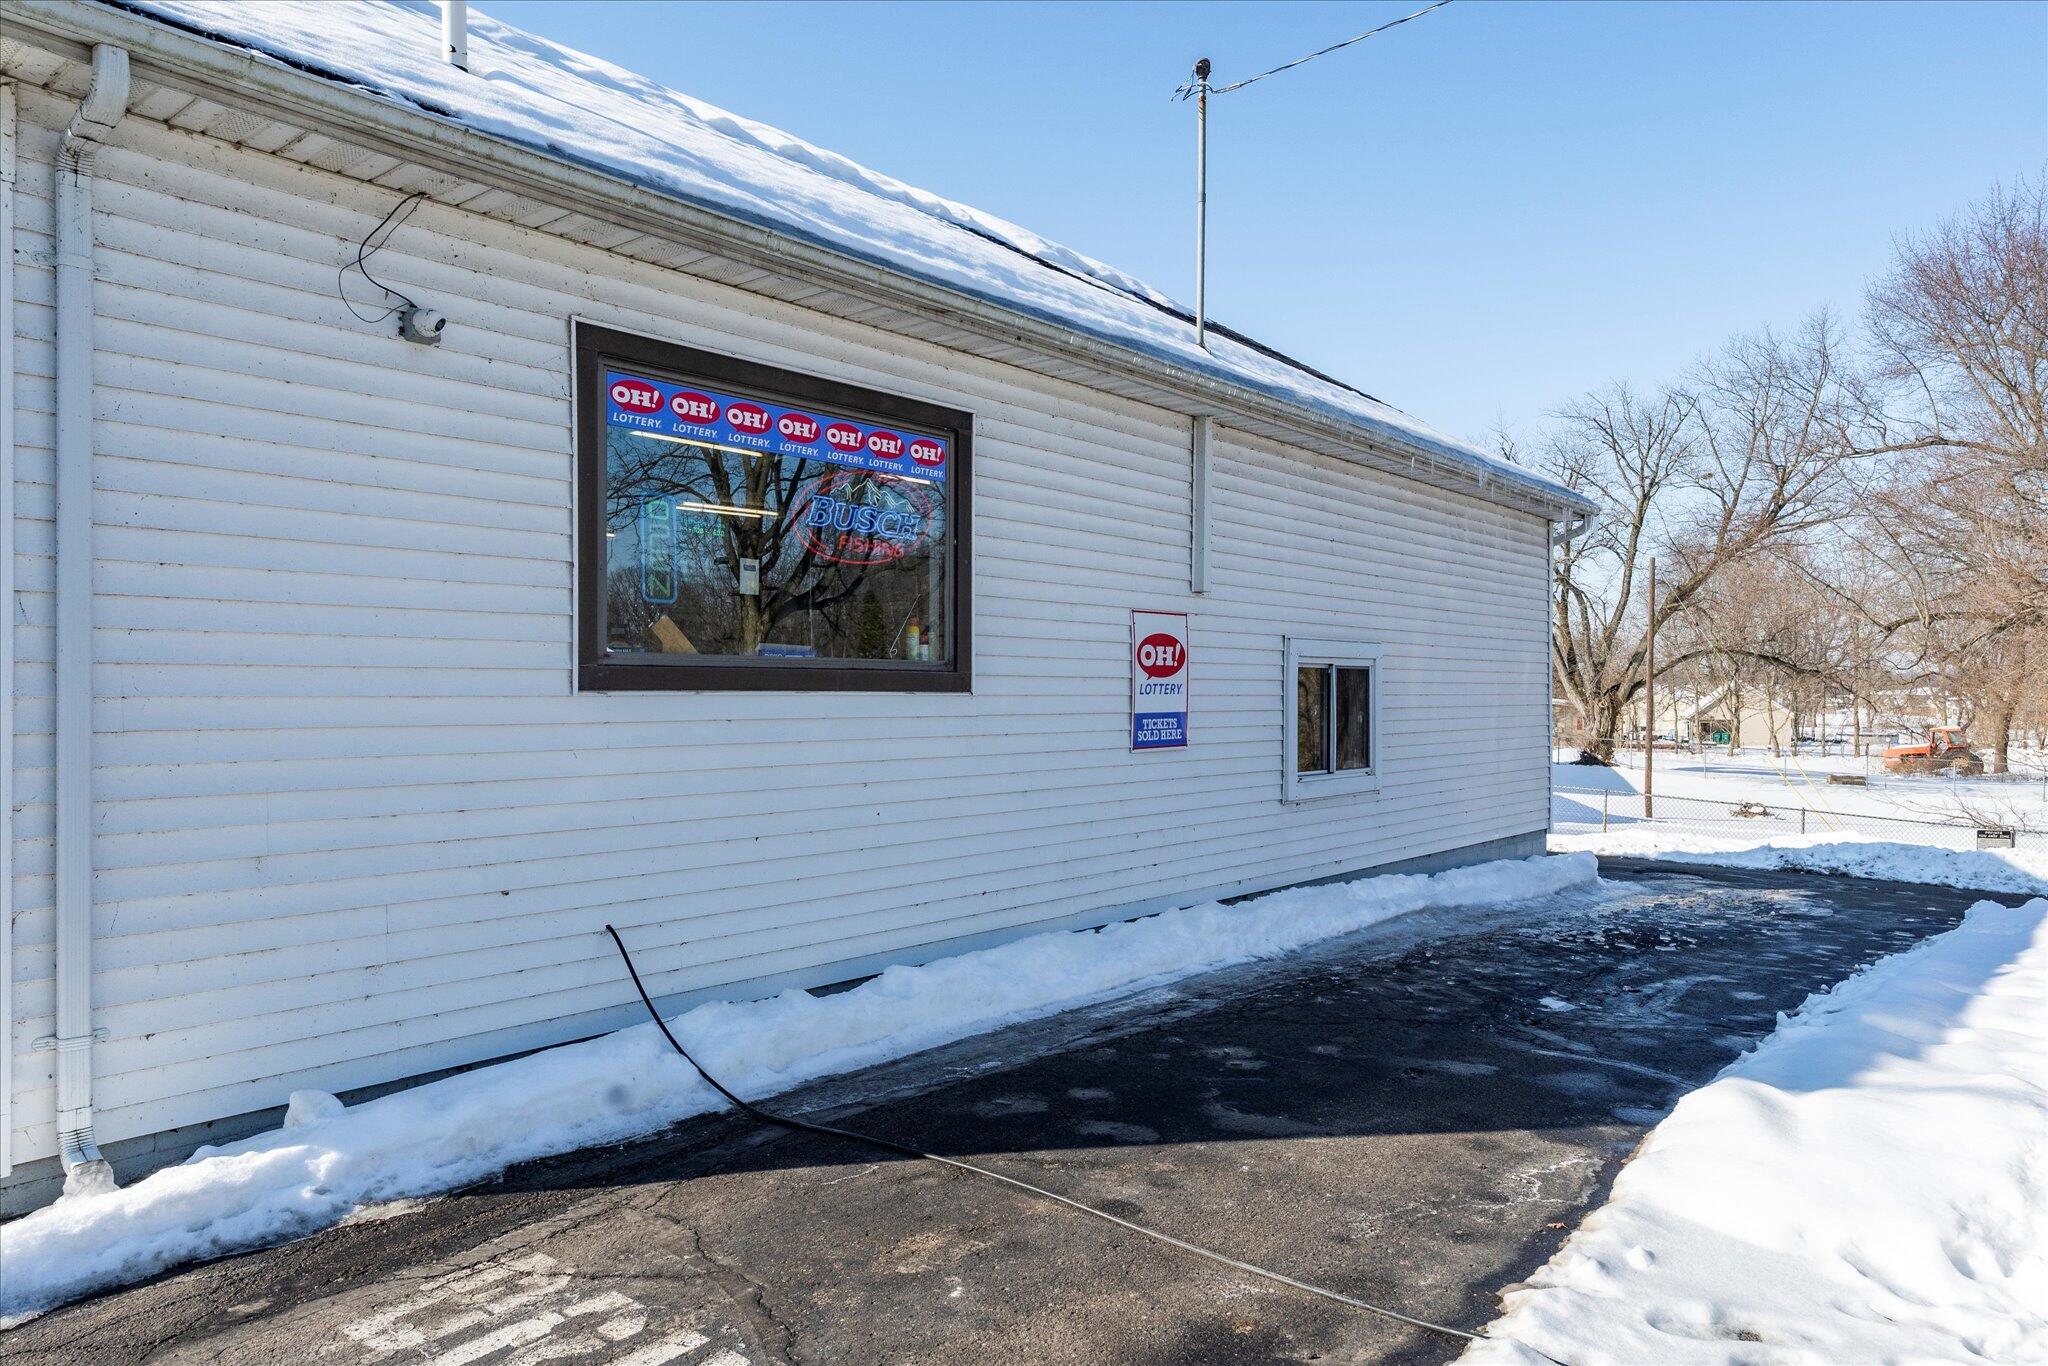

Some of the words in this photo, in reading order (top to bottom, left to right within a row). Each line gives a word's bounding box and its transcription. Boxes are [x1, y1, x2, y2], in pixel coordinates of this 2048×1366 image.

[612, 385, 659, 409] OH!
[671, 397, 716, 419] OH!
[613, 412, 661, 428] LOTTERY
[727, 408, 769, 429] OH!
[672, 422, 717, 438] LOTTERY
[778, 418, 817, 439] OH!
[728, 433, 769, 448] LOTTERY
[826, 428, 862, 448] OH!
[867, 436, 901, 454] OH!
[779, 442, 818, 456] LOTTERY
[910, 444, 942, 462] OH!
[827, 451, 863, 464] LOTTERY
[869, 458, 903, 471] LOTTERY
[911, 466, 944, 478] LOTTERY
[806, 495, 920, 541] BUSCH
[1140, 642, 1181, 667] OH!
[1139, 683, 1182, 695] LOTTERY
[1142, 718, 1177, 730] TICKETS
[1137, 730, 1159, 742] SOLD
[1161, 729, 1182, 740] HERE
